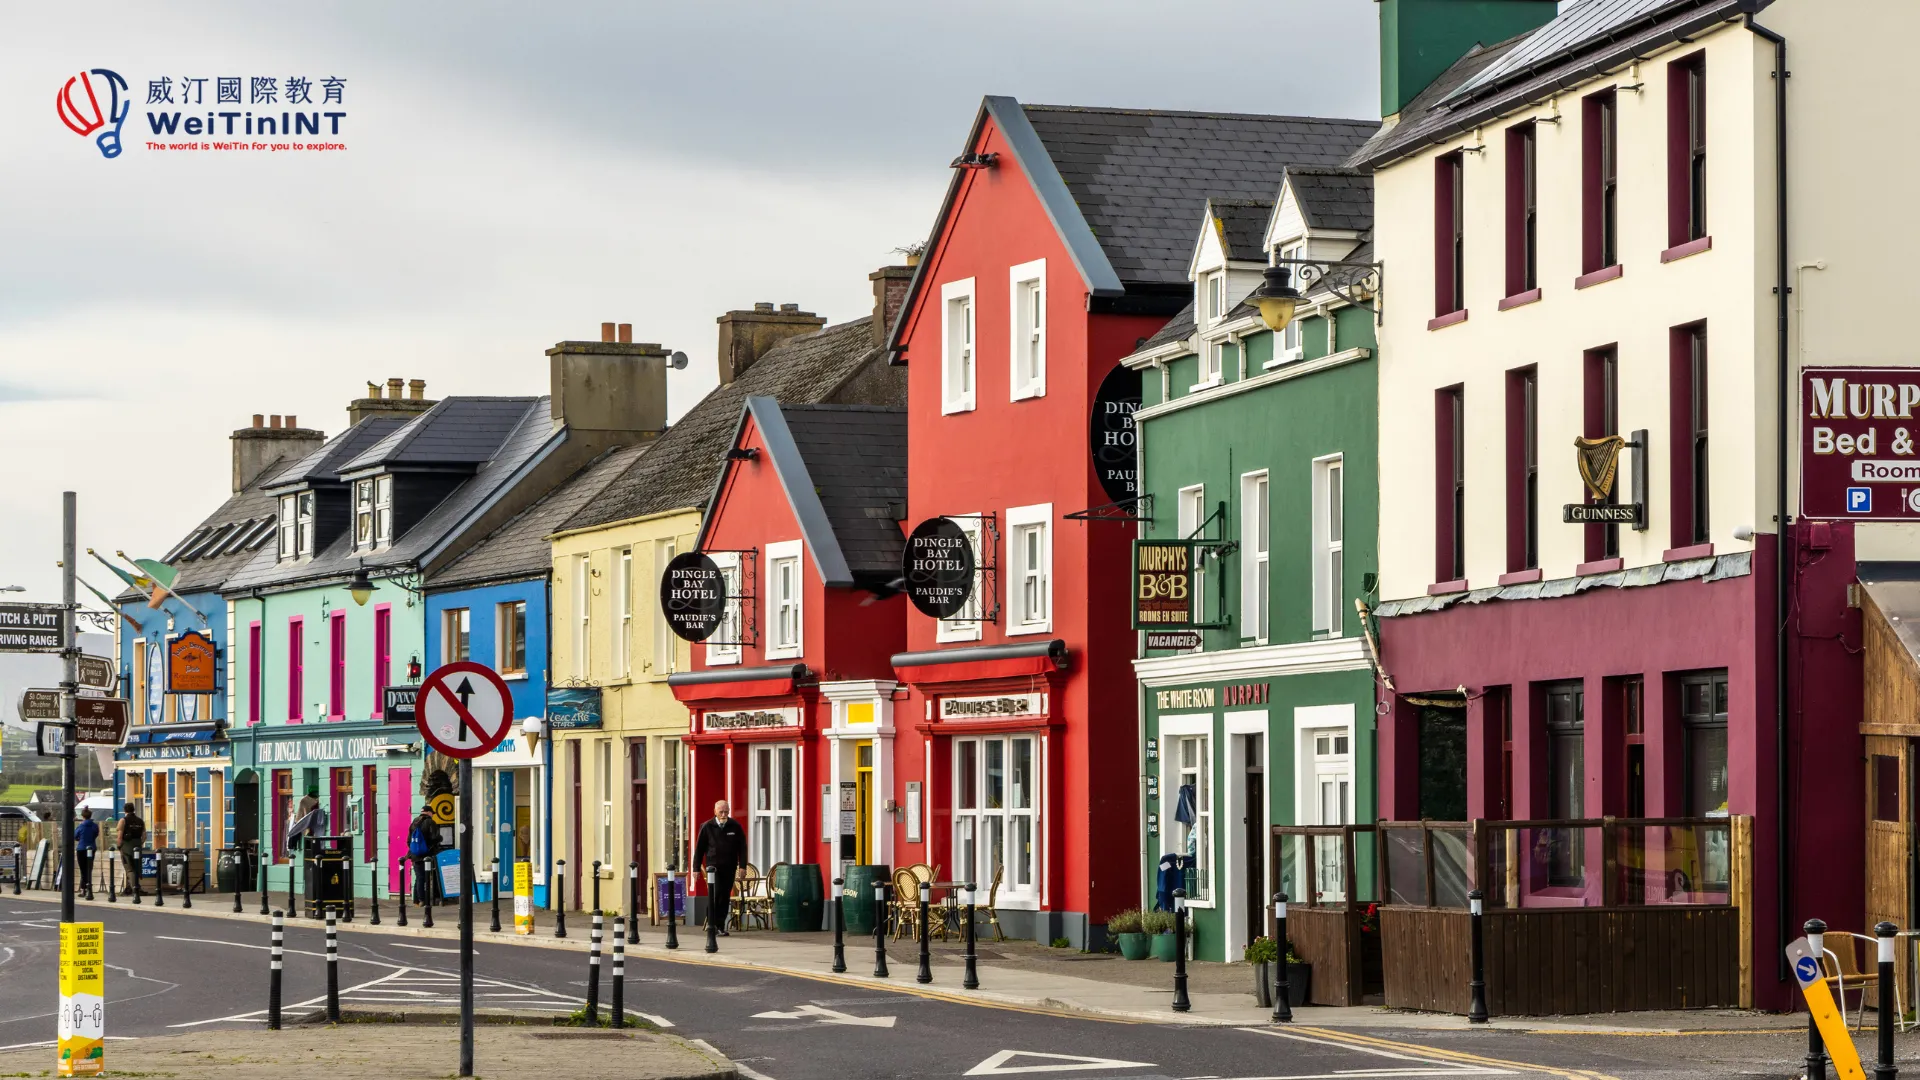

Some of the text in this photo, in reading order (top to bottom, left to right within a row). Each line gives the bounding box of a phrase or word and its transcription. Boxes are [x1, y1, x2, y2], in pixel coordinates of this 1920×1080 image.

[1813, 426, 1916, 455] Bed &
[1852, 491, 1867, 508] P
[1571, 506, 1635, 520] GUINNESS
[913, 537, 964, 548] DINGLE
[927, 548, 951, 559] BAY
[1139, 545, 1187, 571] MURPHYS
[913, 559, 965, 571] HOTEL
[671, 569, 717, 579] DINGLE
[683, 579, 705, 589] BAY
[1139, 573, 1188, 599] B&B
[671, 589, 718, 599] HOTEL
[915, 587, 964, 596] PAUDIE'S
[929, 596, 950, 604] BAR
[23, 613, 31, 625] &
[33, 613, 58, 626] PUTT
[673, 613, 716, 622] PAUDIE'S
[1139, 610, 1188, 622] ROOMS EN SUITE
[685, 621, 705, 629] BAR
[29, 634, 58, 646] RANGE
[1148, 635, 1197, 647] VACANCIES
[1156, 687, 1215, 710] THE WHITE ROOM
[1223, 682, 1269, 707] MURPHY
[139, 744, 210, 759] JOHN BENNY'S PUB
[258, 737, 389, 762] THE DINGLE WOOLLEN COMPANY
